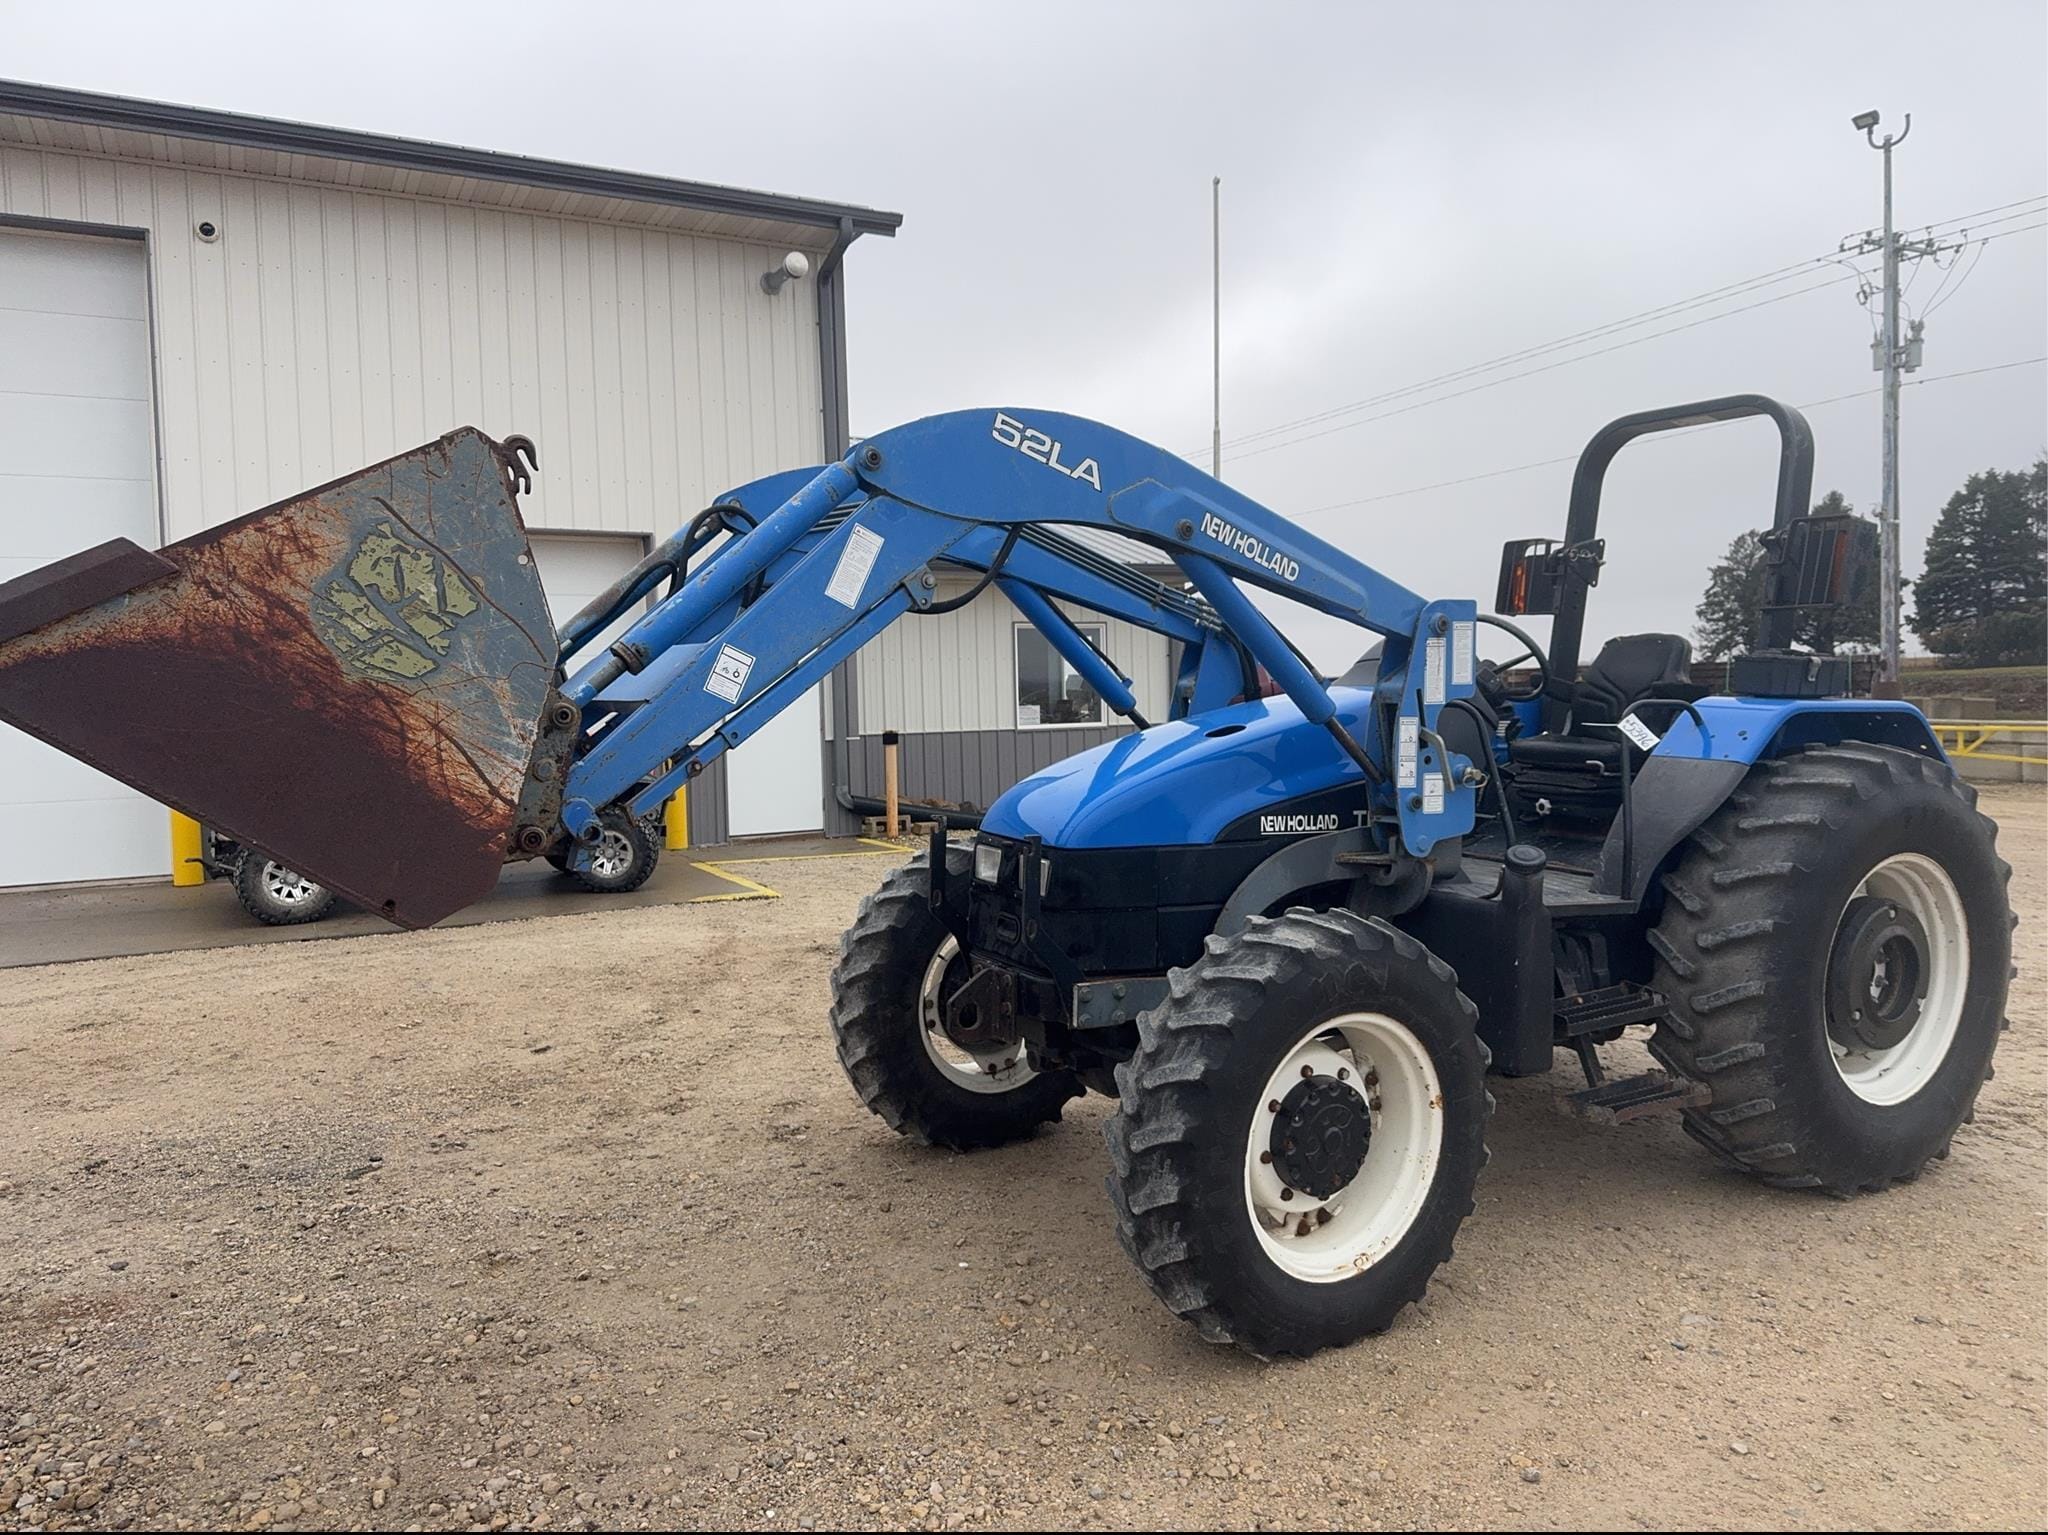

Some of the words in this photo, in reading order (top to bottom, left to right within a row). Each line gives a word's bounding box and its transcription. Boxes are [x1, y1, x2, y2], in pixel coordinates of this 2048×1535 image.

[992, 412, 1102, 492] 52LA
[1201, 512, 1236, 546] NEW
[1232, 530, 1300, 582] HOLLAND
[1260, 815, 1286, 832] NEW
[1287, 814, 1339, 832] HOLLAND
